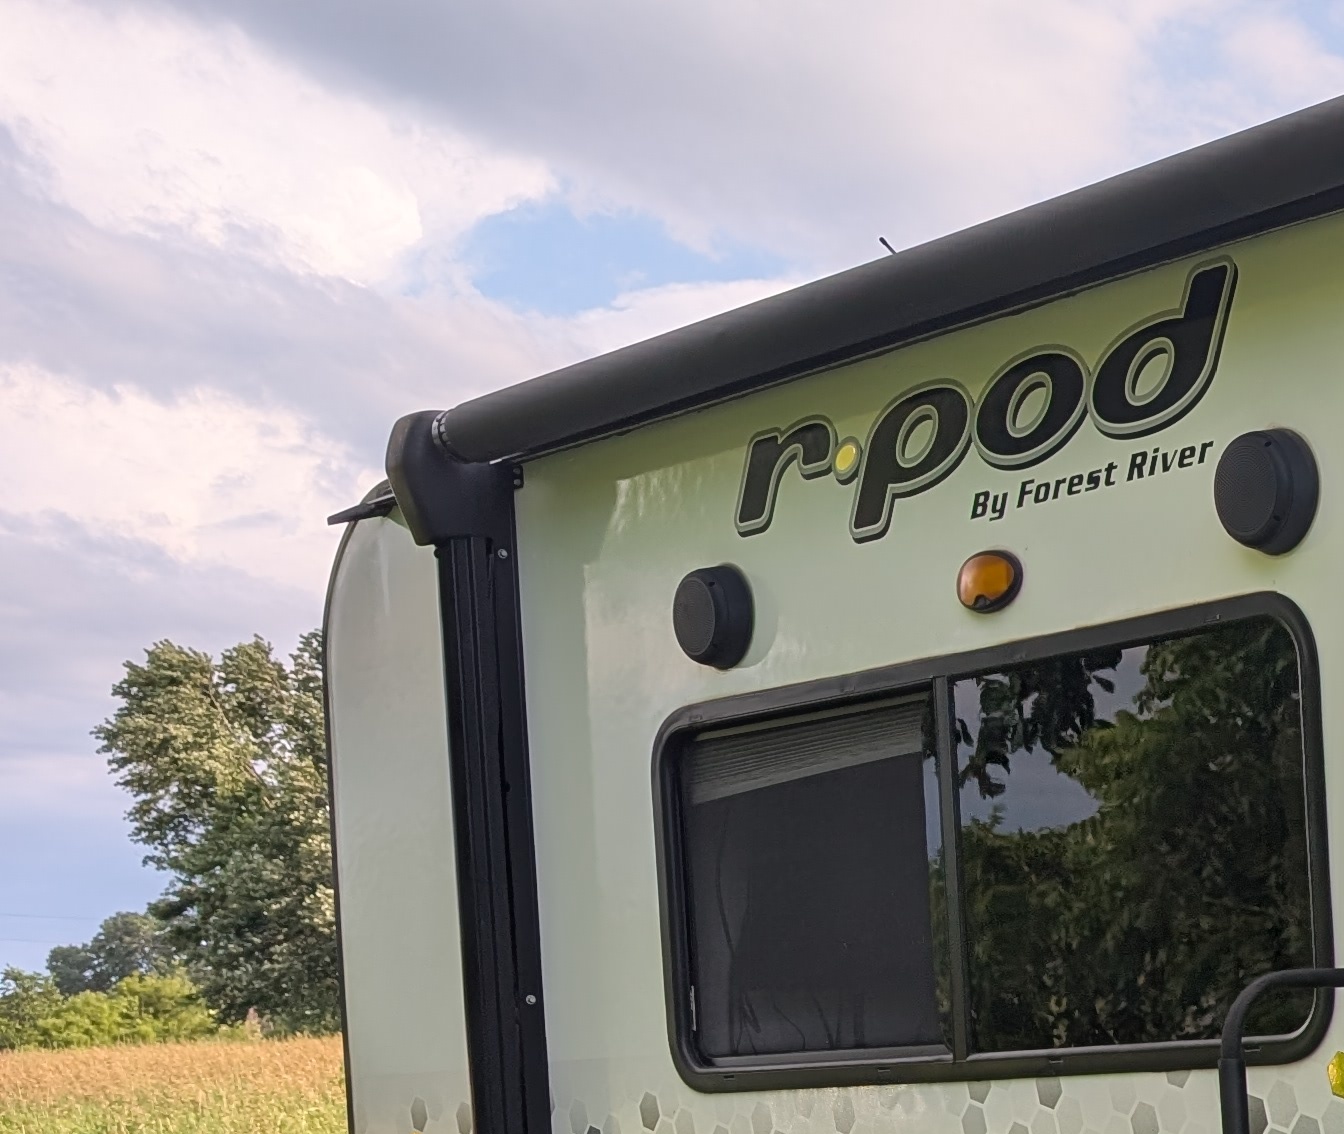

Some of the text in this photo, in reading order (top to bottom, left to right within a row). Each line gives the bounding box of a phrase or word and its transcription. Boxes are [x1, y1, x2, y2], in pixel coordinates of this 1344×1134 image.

[970, 441, 1214, 522] By Forest River
